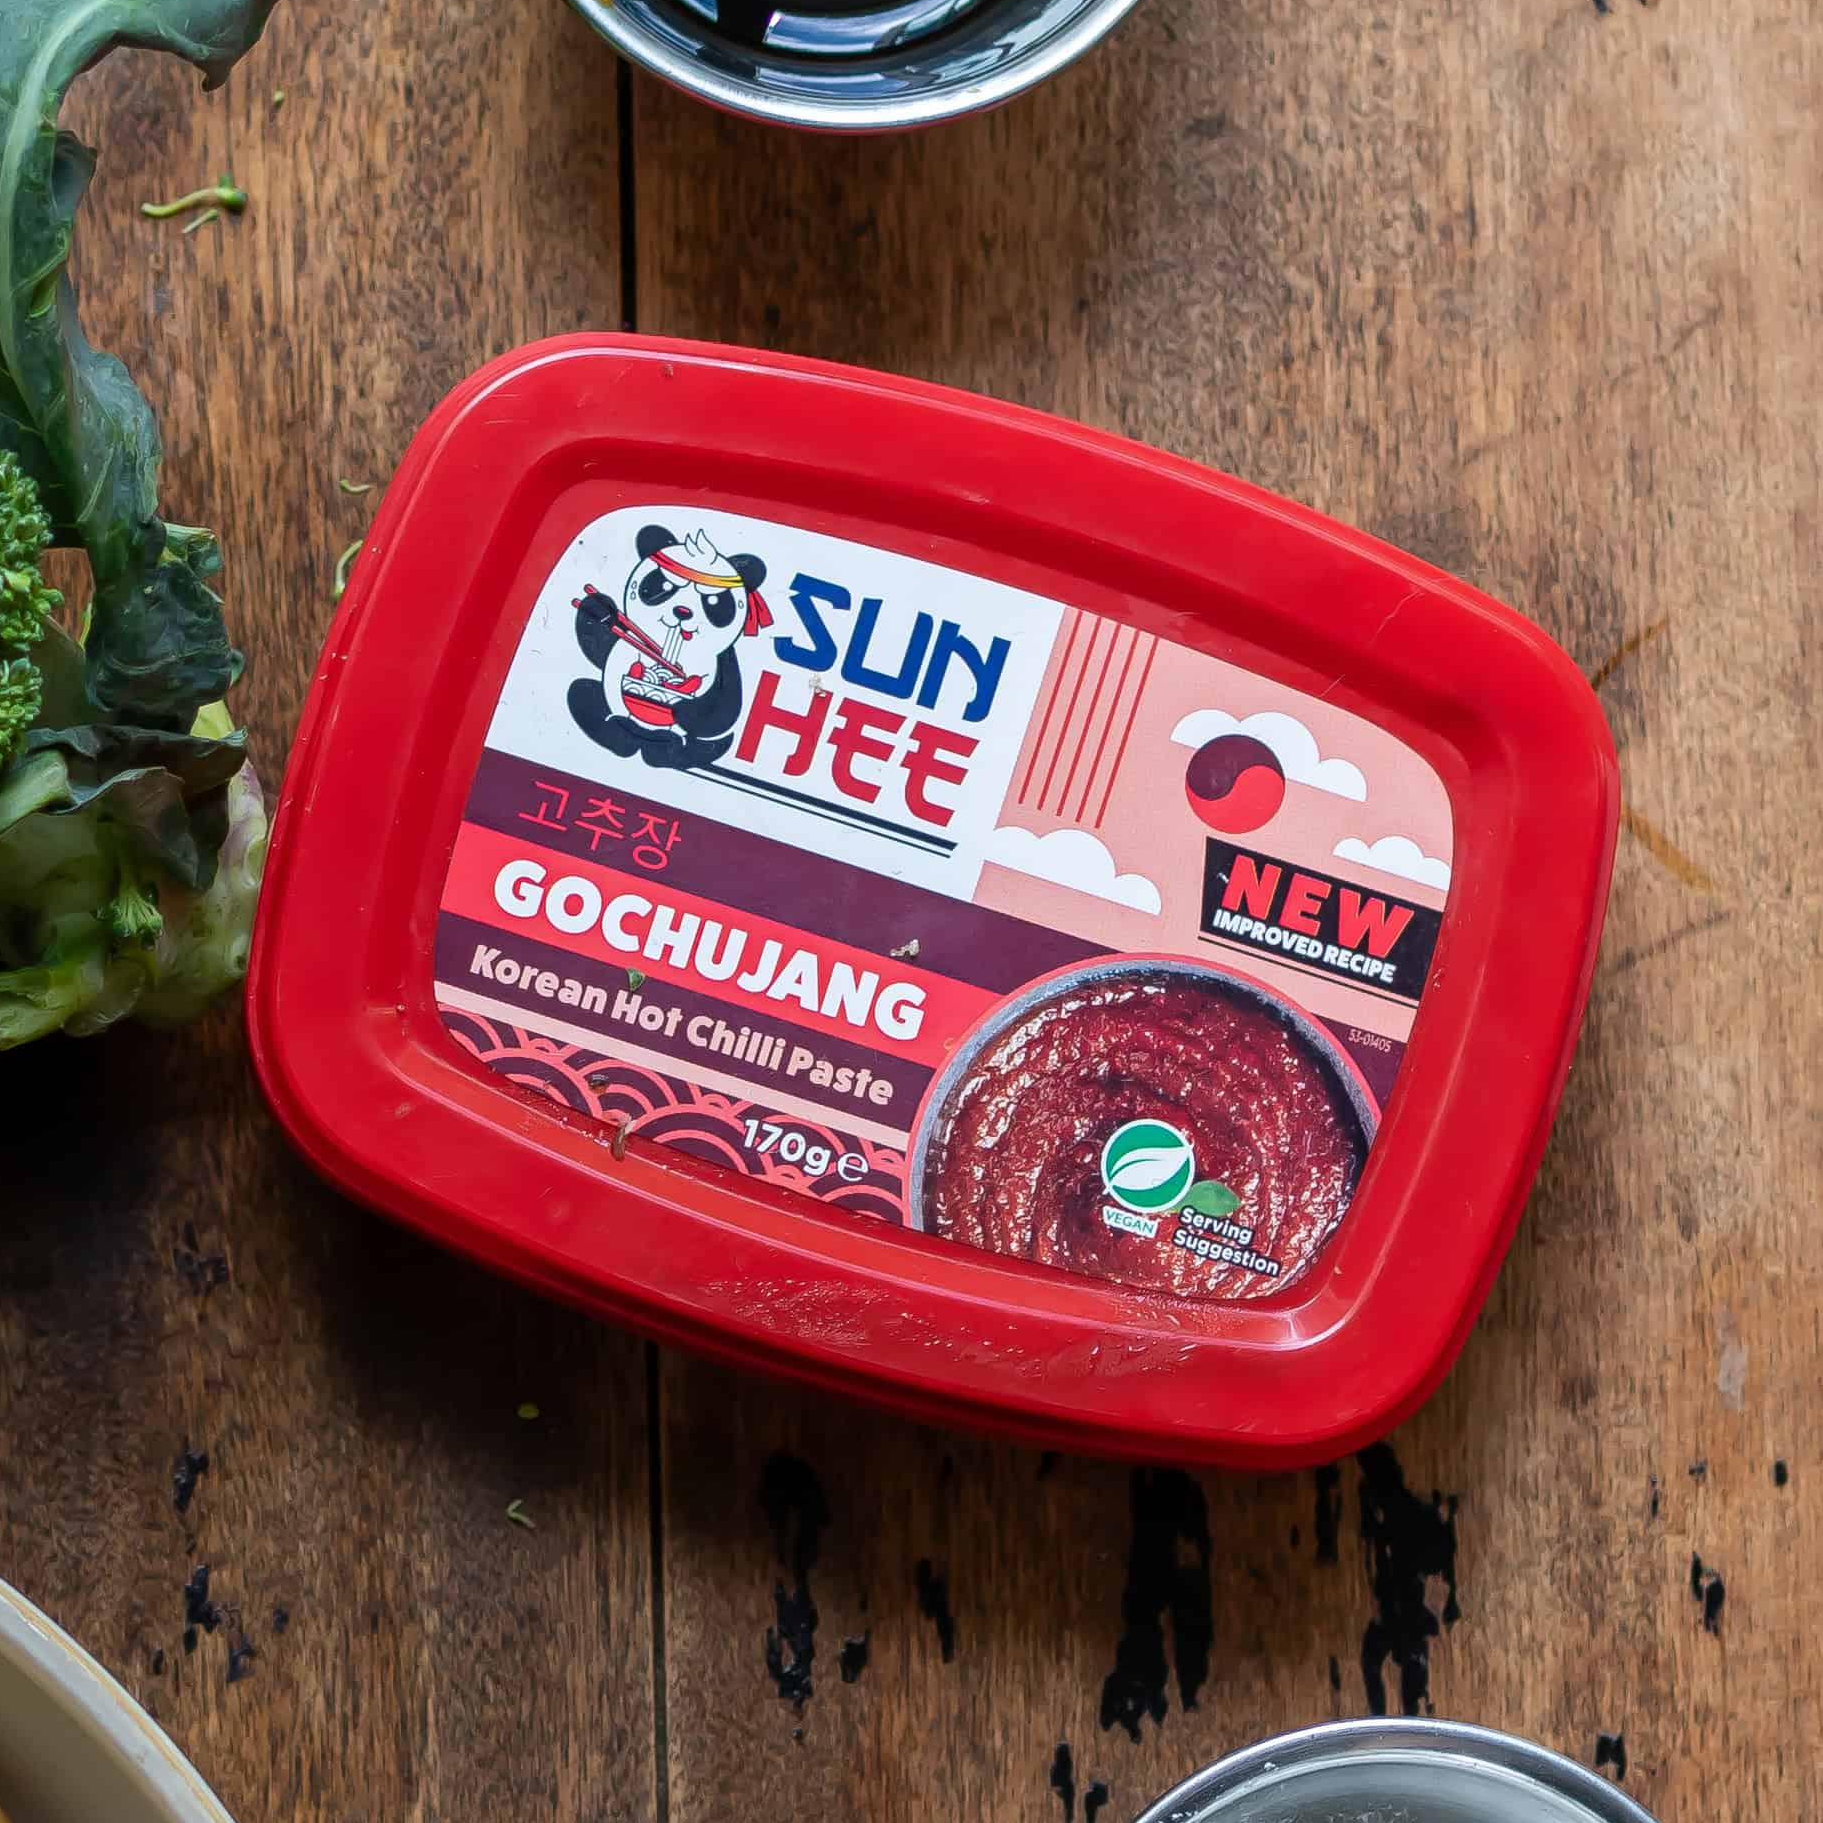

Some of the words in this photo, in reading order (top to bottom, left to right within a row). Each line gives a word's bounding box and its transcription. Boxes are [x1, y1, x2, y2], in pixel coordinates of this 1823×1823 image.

[773, 573, 1011, 721] SUN
[735, 670, 979, 827] HEE
[518, 781, 682, 870] 고추장
[494, 859, 926, 1040] GOCHUJANG
[1213, 909, 1323, 959] IMPROVED
[1323, 944, 1397, 983] RECIPE
[1221, 854, 1414, 958] NEW
[470, 944, 608, 1014] Korean
[612, 989, 682, 1038] Hot
[686, 1015, 786, 1072] Chilli
[787, 1047, 894, 1106] Paste
[744, 1118, 832, 1177] 170g
[1105, 1210, 1156, 1234] VEGAN
[1174, 1229, 1279, 1276] Suggestion
[1181, 1207, 1253, 1245] Serving
